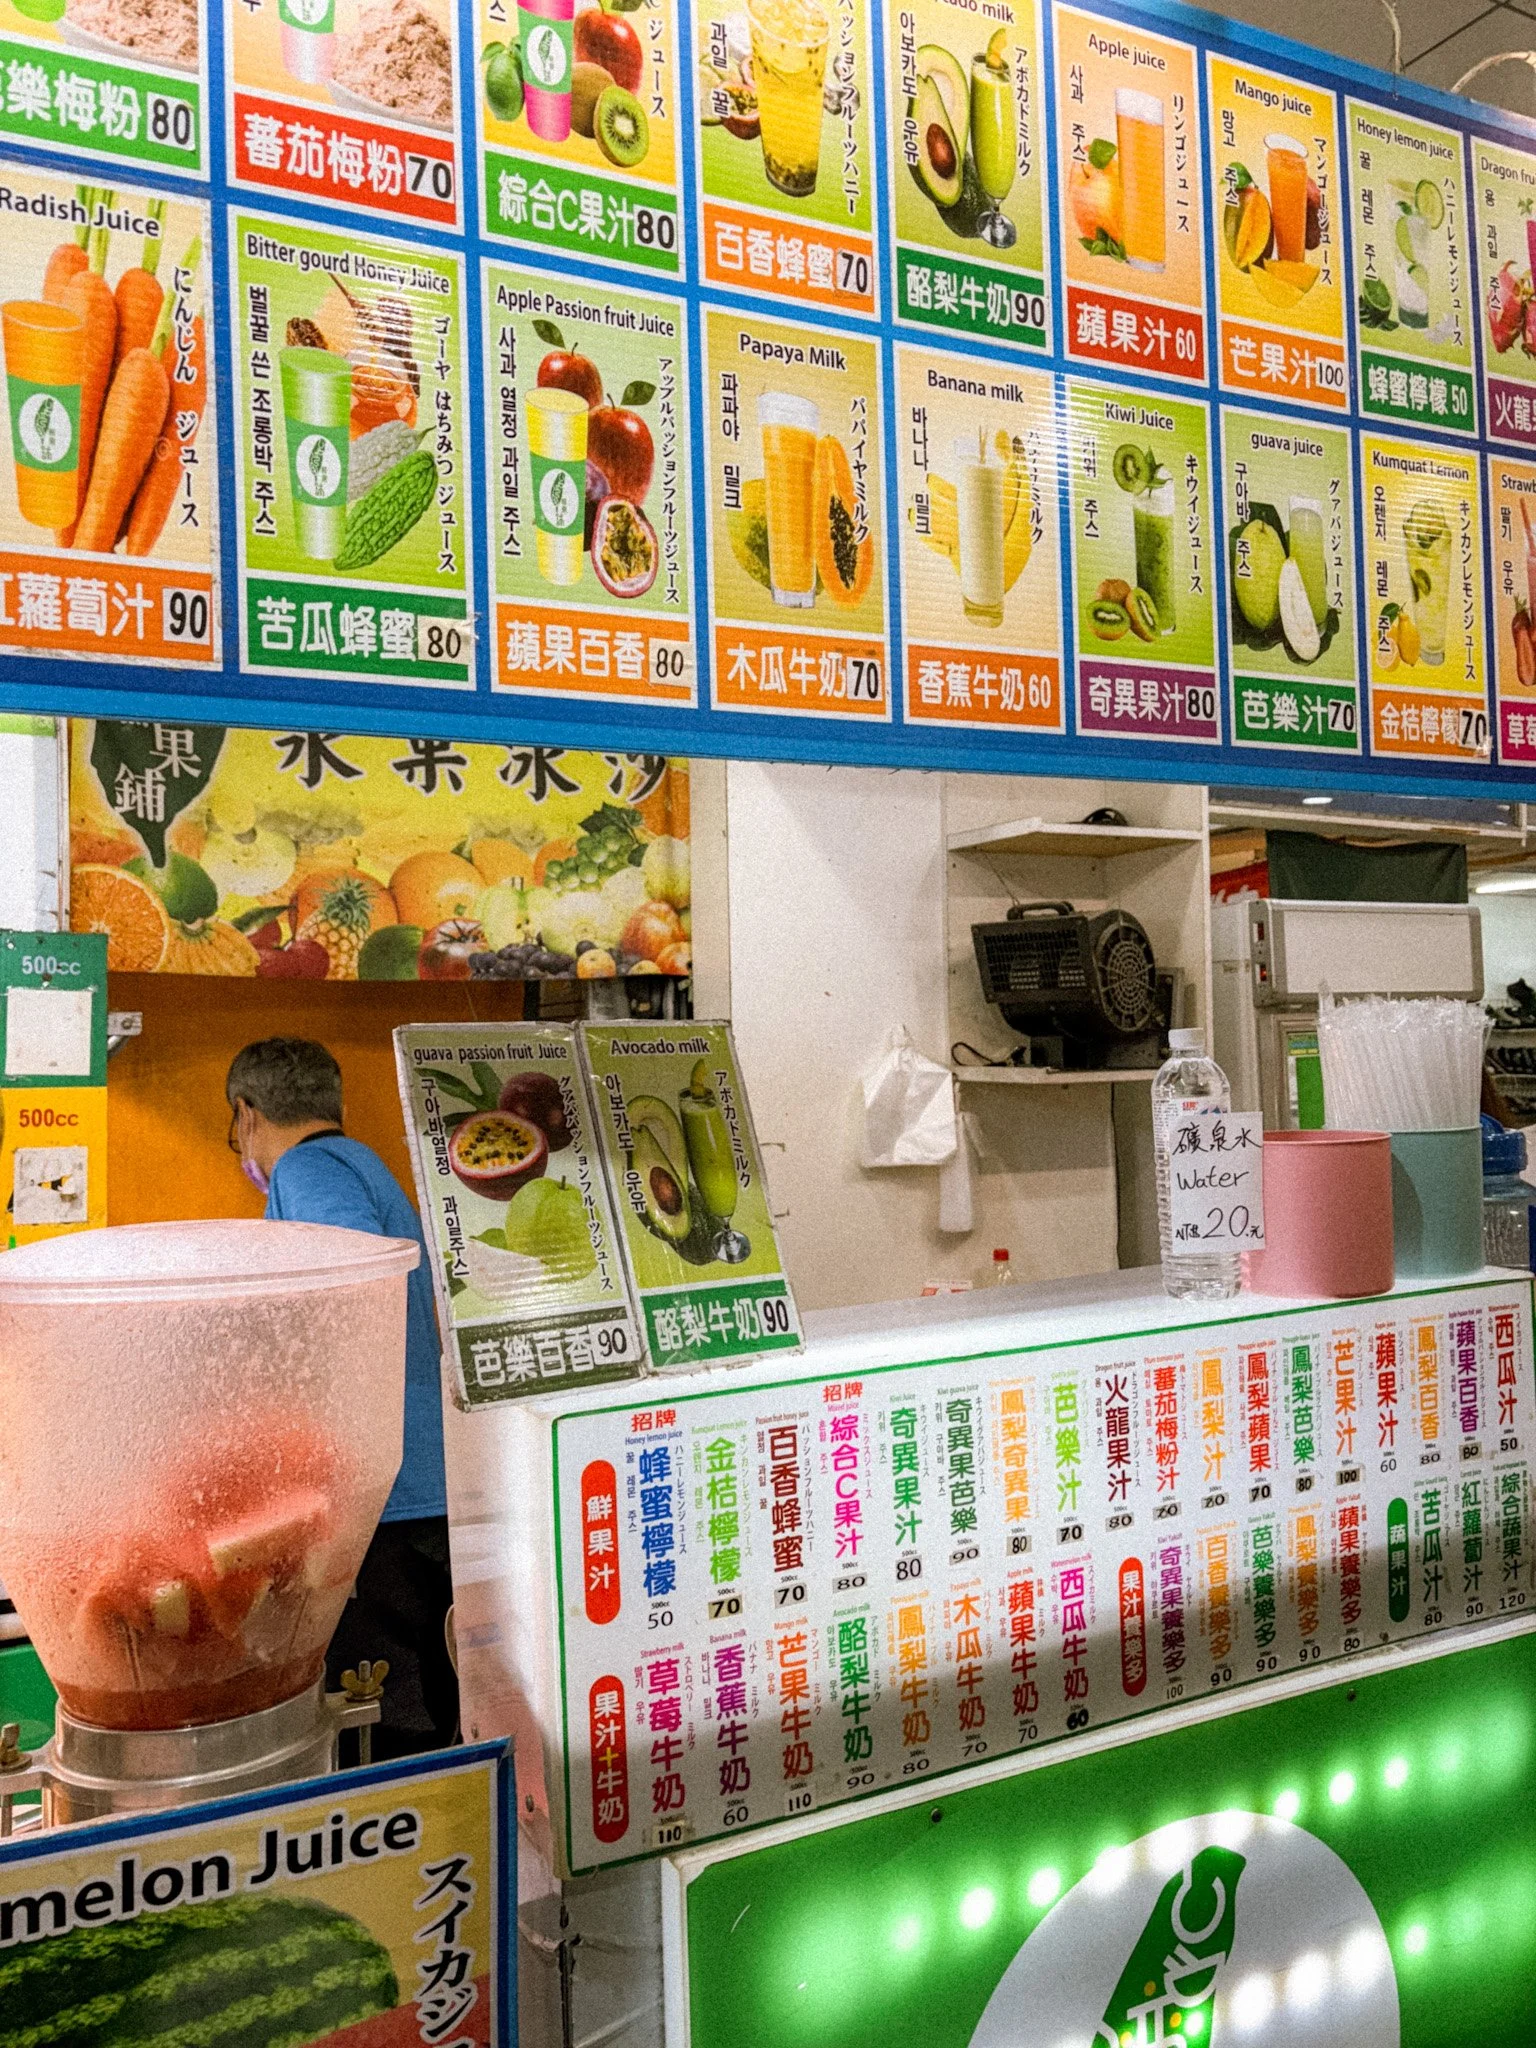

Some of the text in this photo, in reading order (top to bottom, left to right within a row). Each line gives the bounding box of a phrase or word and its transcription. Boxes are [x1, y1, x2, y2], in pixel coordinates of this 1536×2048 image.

[983, 4, 1014, 24] milk
[711, 22, 727, 69] 과일
[1089, 34, 1166, 71] Apple juice
[0, 58, 191, 146] 樂梅粉 80
[1070, 65, 1086, 162] 사과 주스
[1235, 79, 1312, 116] Mango juice
[243, 111, 452, 199] 蕃茄梅粉 70
[904, 119, 918, 163] 우유
[1173, 94, 1190, 232] リンゴジュース
[1222, 110, 1238, 205] 망고 주스
[1357, 118, 1454, 161] Honey lemon juice
[1481, 156, 1519, 180] Dragon
[0, 188, 159, 237] Radish Juice
[498, 170, 675, 249] 綜合C果汁 80
[246, 233, 450, 294] Bitter gourd Honey Juice
[715, 221, 868, 293] 百香蜂蜜 70
[1364, 243, 1378, 280] 주스
[497, 285, 674, 337] Apple Passion fruit Juice
[906, 264, 1045, 327] 酪梨牛奶 90
[1489, 276, 1502, 311] 주스
[740, 334, 846, 370] Papaya Milk
[1076, 302, 1196, 362] 蘋果汁 60
[928, 370, 1024, 403] Banana milk
[1229, 335, 1344, 389] 芒果汁 100
[174, 266, 199, 527] にんじん ジュース
[1105, 402, 1174, 430] Kiwi Juice
[1368, 364, 1468, 416] 蜂蜜檸檬 50
[499, 327, 521, 556] 사과 과일 주스
[721, 373, 742, 508] 파파야 밀크
[1251, 434, 1323, 456] guava juice
[1373, 451, 1428, 475] Kumquat
[434, 390, 456, 572] はちみつ ジュース
[850, 397, 870, 542] パパイヤミルク
[912, 407, 931, 534] 바나나 밀크
[254, 482, 276, 535] 주스
[1084, 499, 1099, 538] 주스
[1235, 462, 1251, 577] 구아바 주스
[1503, 560, 1514, 594] 우유
[169, 591, 208, 638] 90
[257, 596, 462, 662] 苦瓜蜂蜜 80
[1378, 616, 1391, 653] 주스
[506, 620, 684, 680] 蘋果百香 80
[727, 642, 879, 699] 木瓜牛奶 70
[918, 660, 1051, 712] 香蕉牛奶 60
[1089, 675, 1215, 723] 奇異果汁 80
[1242, 690, 1355, 735] 芭樂汁 70
[1462, 710, 1487, 746] 70
[22, 955, 81, 975] 500cc
[414, 1044, 567, 1065] guava passion fruit Juice
[611, 1039, 710, 1055] Avocado milk
[19, 1109, 79, 1128] 500cc
[606, 1074, 647, 1212] 아보카도 우유
[1172, 1120, 1263, 1156] 礦泉水
[1177, 1165, 1250, 1192] Water
[653, 1297, 790, 1352] 酪梨牛奶 90
[471, 1326, 627, 1387] 芭樂百香 90
[1457, 1320, 1479, 1433] 蘋果百香
[1495, 1314, 1518, 1425] 西瓜汁
[822, 1381, 863, 1403] 招牌
[1334, 1338, 1357, 1456] 芒果汁
[1376, 1332, 1398, 1448] 蘋果汁
[625, 1434, 646, 1446] Honey
[647, 1433, 666, 1443] lemon
[631, 1409, 677, 1432] 招牌
[1053, 1382, 1082, 1512] 芭樂汁
[1106, 1374, 1132, 1502] 火龍果汁
[1500, 1437, 1518, 1451] 50
[830, 1414, 864, 1558] 綜合C果汁
[890, 1406, 923, 1546] 奇異果汁
[946, 1399, 978, 1535] 奇異果芭樂
[1380, 1459, 1397, 1473] 60
[639, 1446, 677, 1598] 蜂蜜檸檬
[706, 1437, 742, 1584] 金桔檸檬
[768, 1425, 804, 1573] 百香蜂蜜
[586, 1495, 615, 1591] 鮮果汁
[896, 1558, 922, 1580] 80
[952, 1548, 979, 1562] 90
[1421, 1488, 1443, 1602] 苦瓜汁
[712, 1599, 740, 1618] 70
[777, 1585, 805, 1605] 70
[837, 1575, 865, 1590] 80
[648, 1611, 674, 1630] 50
[709, 1629, 747, 1644] Banana milk
[1060, 1567, 1089, 1702] 西瓜牛奶
[954, 1594, 985, 1732] 木瓜牛奶
[1008, 1580, 1039, 1716] 蘋果牛奶
[1256, 1657, 1277, 1672] 90
[838, 1617, 873, 1763] 酪梨牛奶
[899, 1605, 930, 1747] 鳳梨牛奶
[714, 1643, 750, 1796] 香蕉牛奶
[777, 1631, 813, 1780] 芒果牛奶
[647, 1659, 686, 1814] 草莓牛奶
[1018, 1725, 1038, 1743] 70
[847, 1773, 875, 1789] 90
[903, 1759, 930, 1775] 80
[723, 1806, 749, 1826] 60
[250, 1813, 418, 1885] Juice
[416, 1857, 474, 2048] スイカジ
